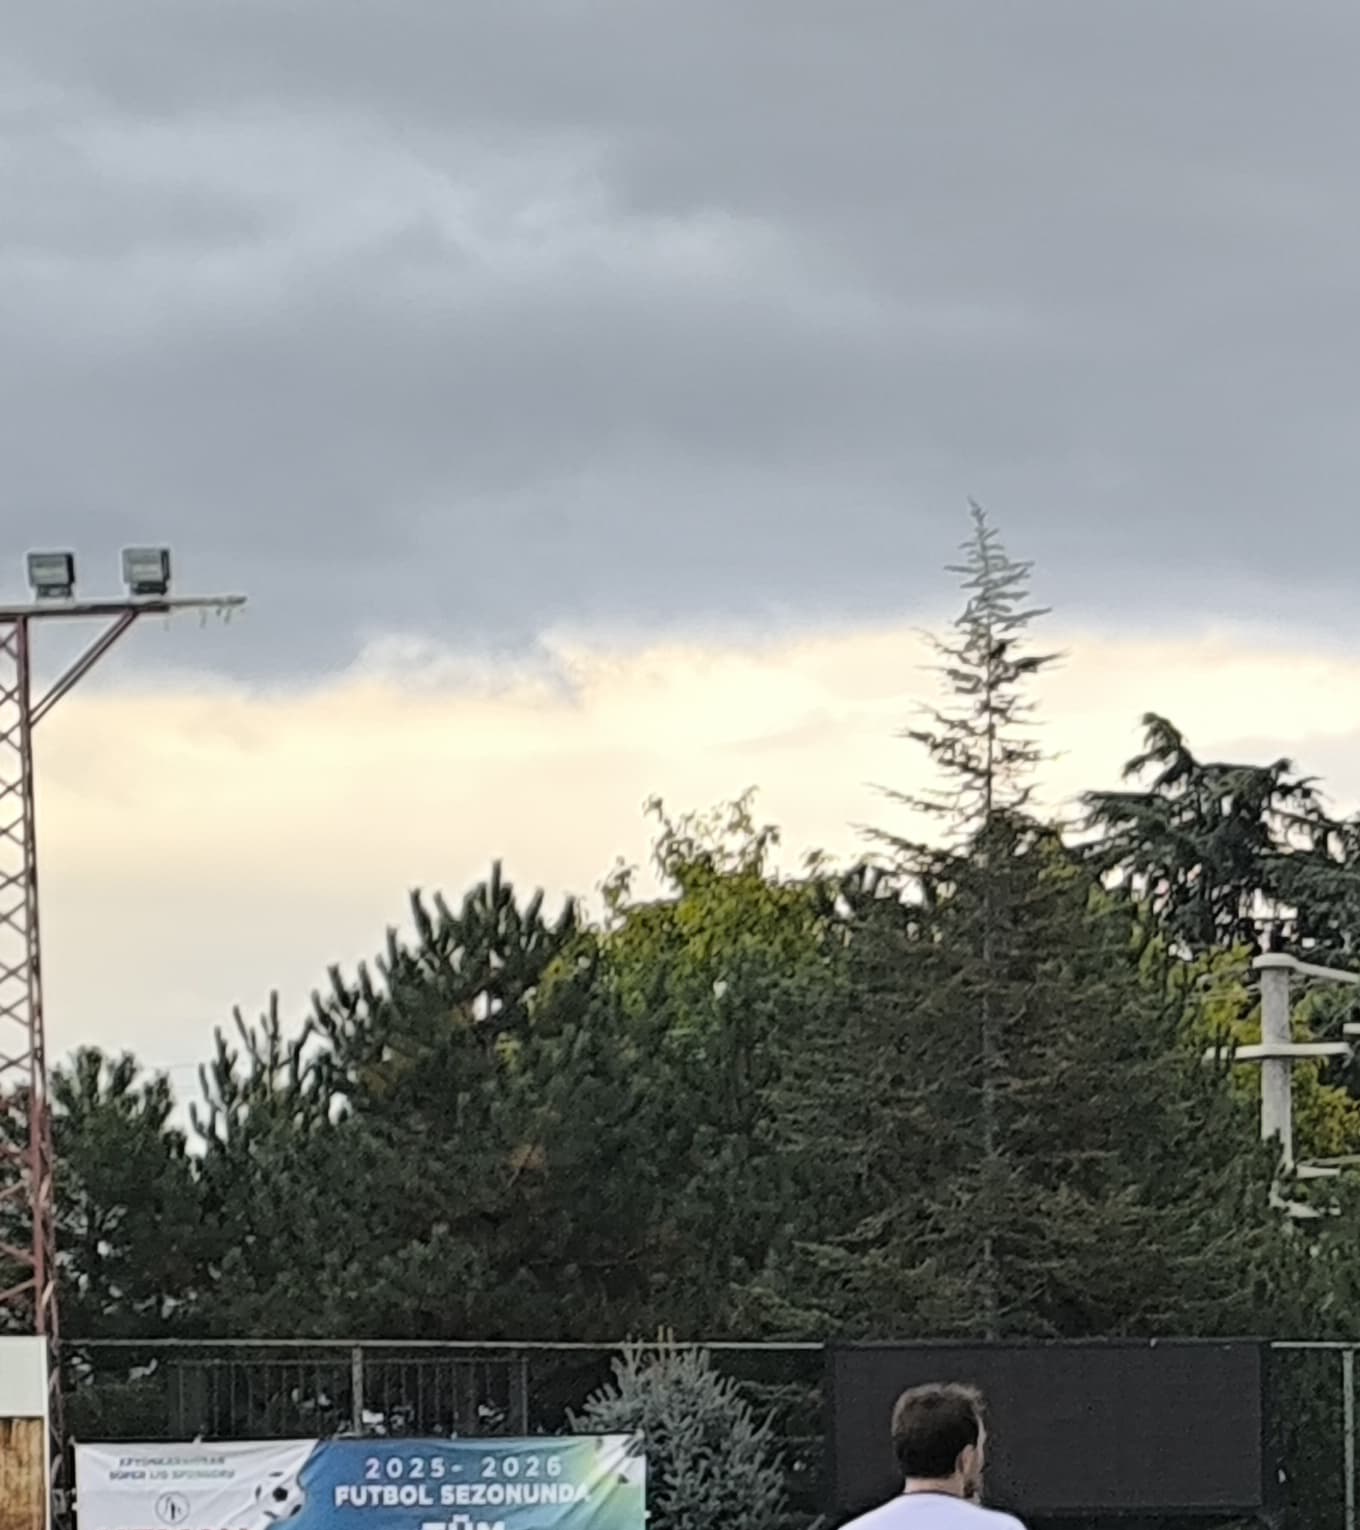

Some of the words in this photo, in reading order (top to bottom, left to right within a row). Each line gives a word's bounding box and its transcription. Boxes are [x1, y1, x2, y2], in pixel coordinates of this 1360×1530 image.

[482, 1457, 562, 1477] 2026
[335, 1485, 434, 1506] FUTBOL
[441, 1484, 591, 1505] SEZONUNDA
